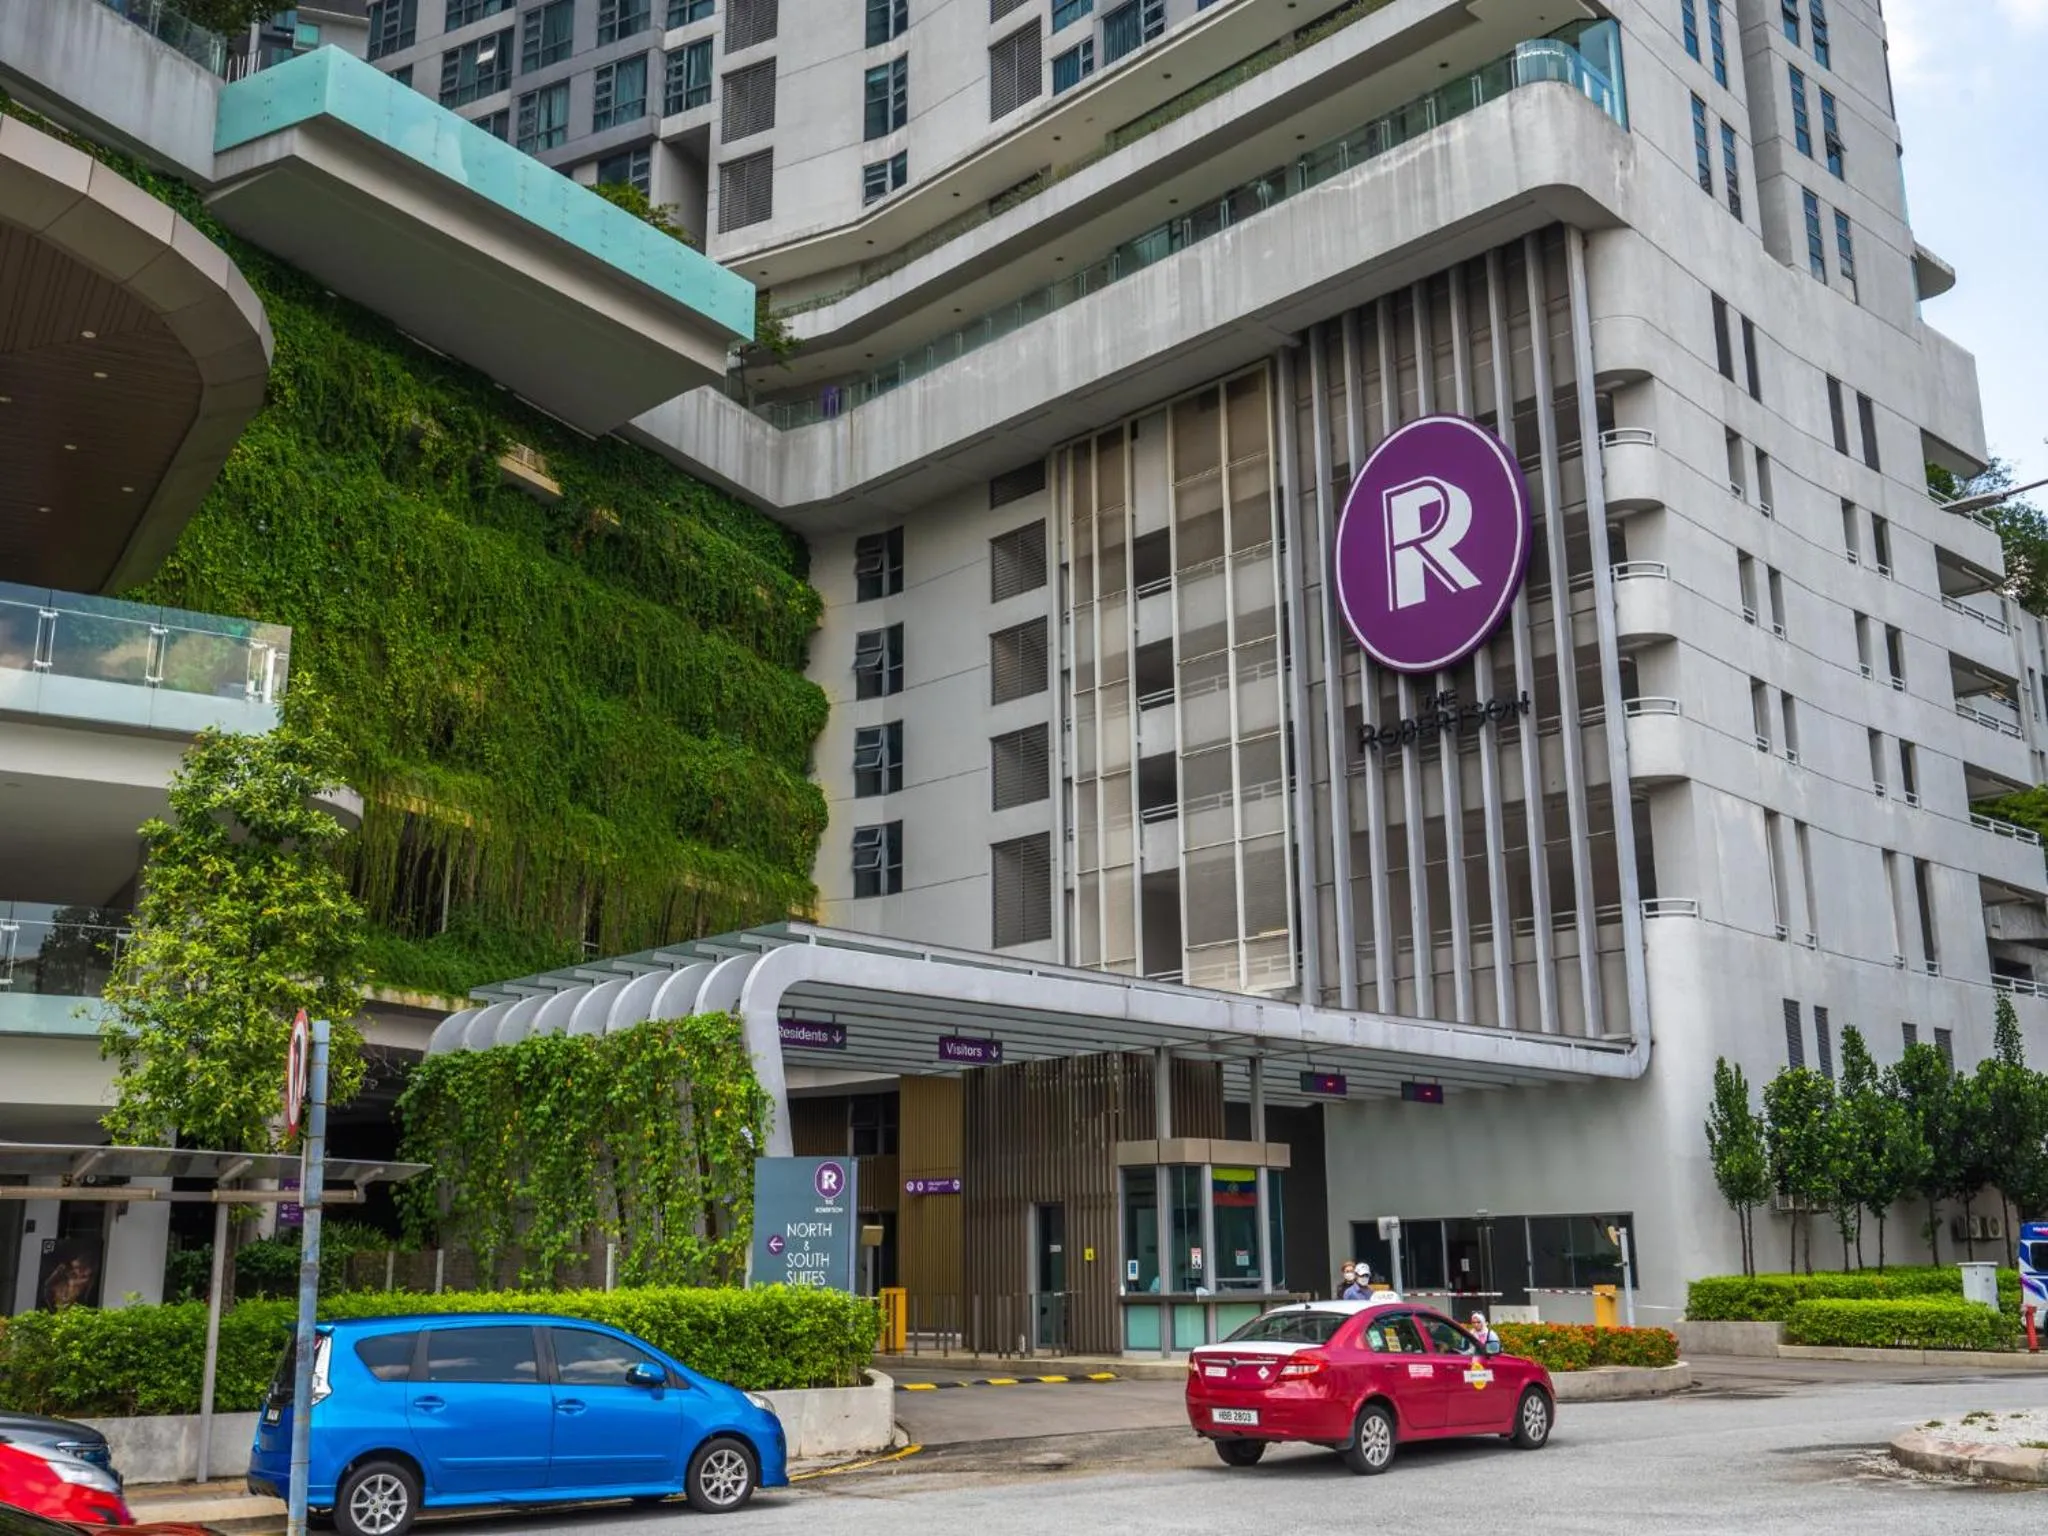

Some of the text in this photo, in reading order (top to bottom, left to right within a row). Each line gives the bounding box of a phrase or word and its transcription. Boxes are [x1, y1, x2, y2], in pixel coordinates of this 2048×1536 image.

[1382, 476, 1482, 612] R
[1423, 689, 1458, 711] THE
[1358, 691, 1531, 754] ROBERTSON
[777, 1025, 828, 1043] Residents
[946, 1042, 983, 1058] Visitors
[821, 1169, 838, 1190] R
[786, 1222, 833, 1238] NORTH
[803, 1240, 810, 1251] &
[786, 1252, 830, 1268] SOUTH
[785, 1270, 826, 1286] SUITES
